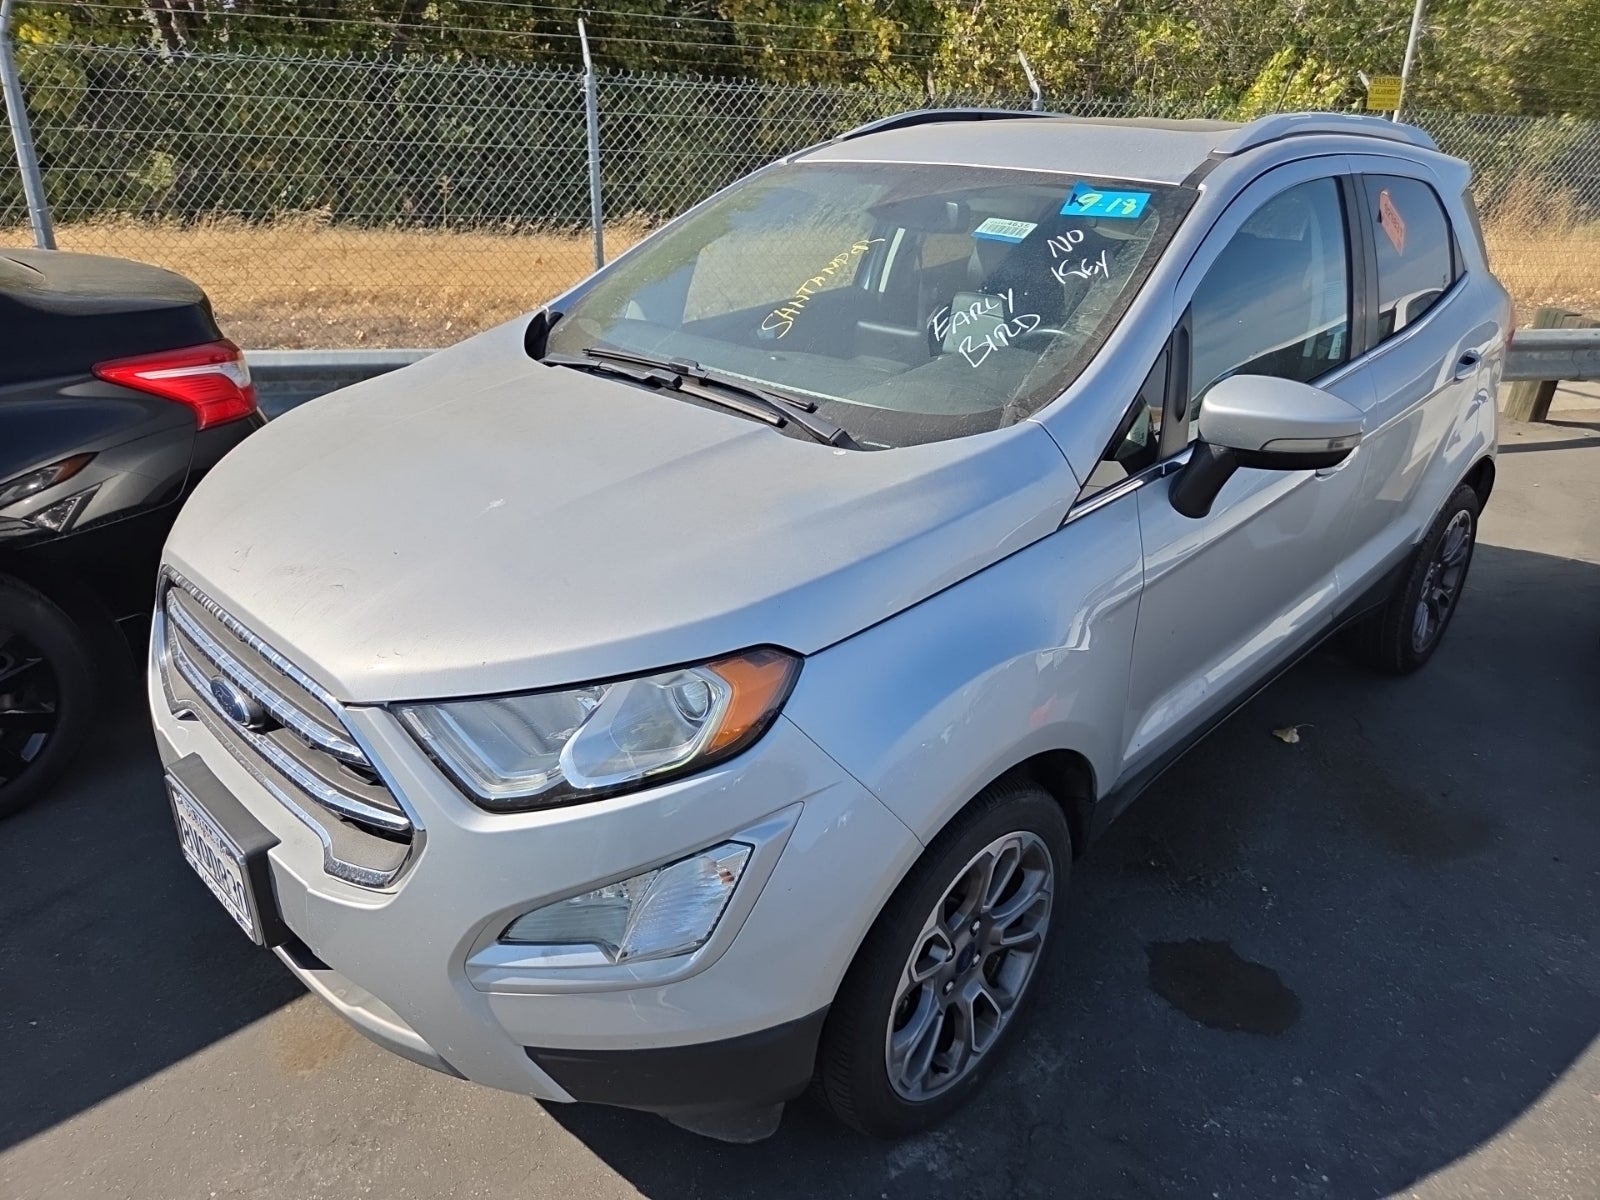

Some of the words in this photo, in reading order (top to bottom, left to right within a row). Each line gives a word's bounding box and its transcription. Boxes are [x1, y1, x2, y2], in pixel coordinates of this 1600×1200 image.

[1047, 229, 1084, 258] NO
[1050, 250, 1109, 285] KEY
[932, 288, 1014, 342] EARLY
[958, 314, 1041, 368] BIRD
